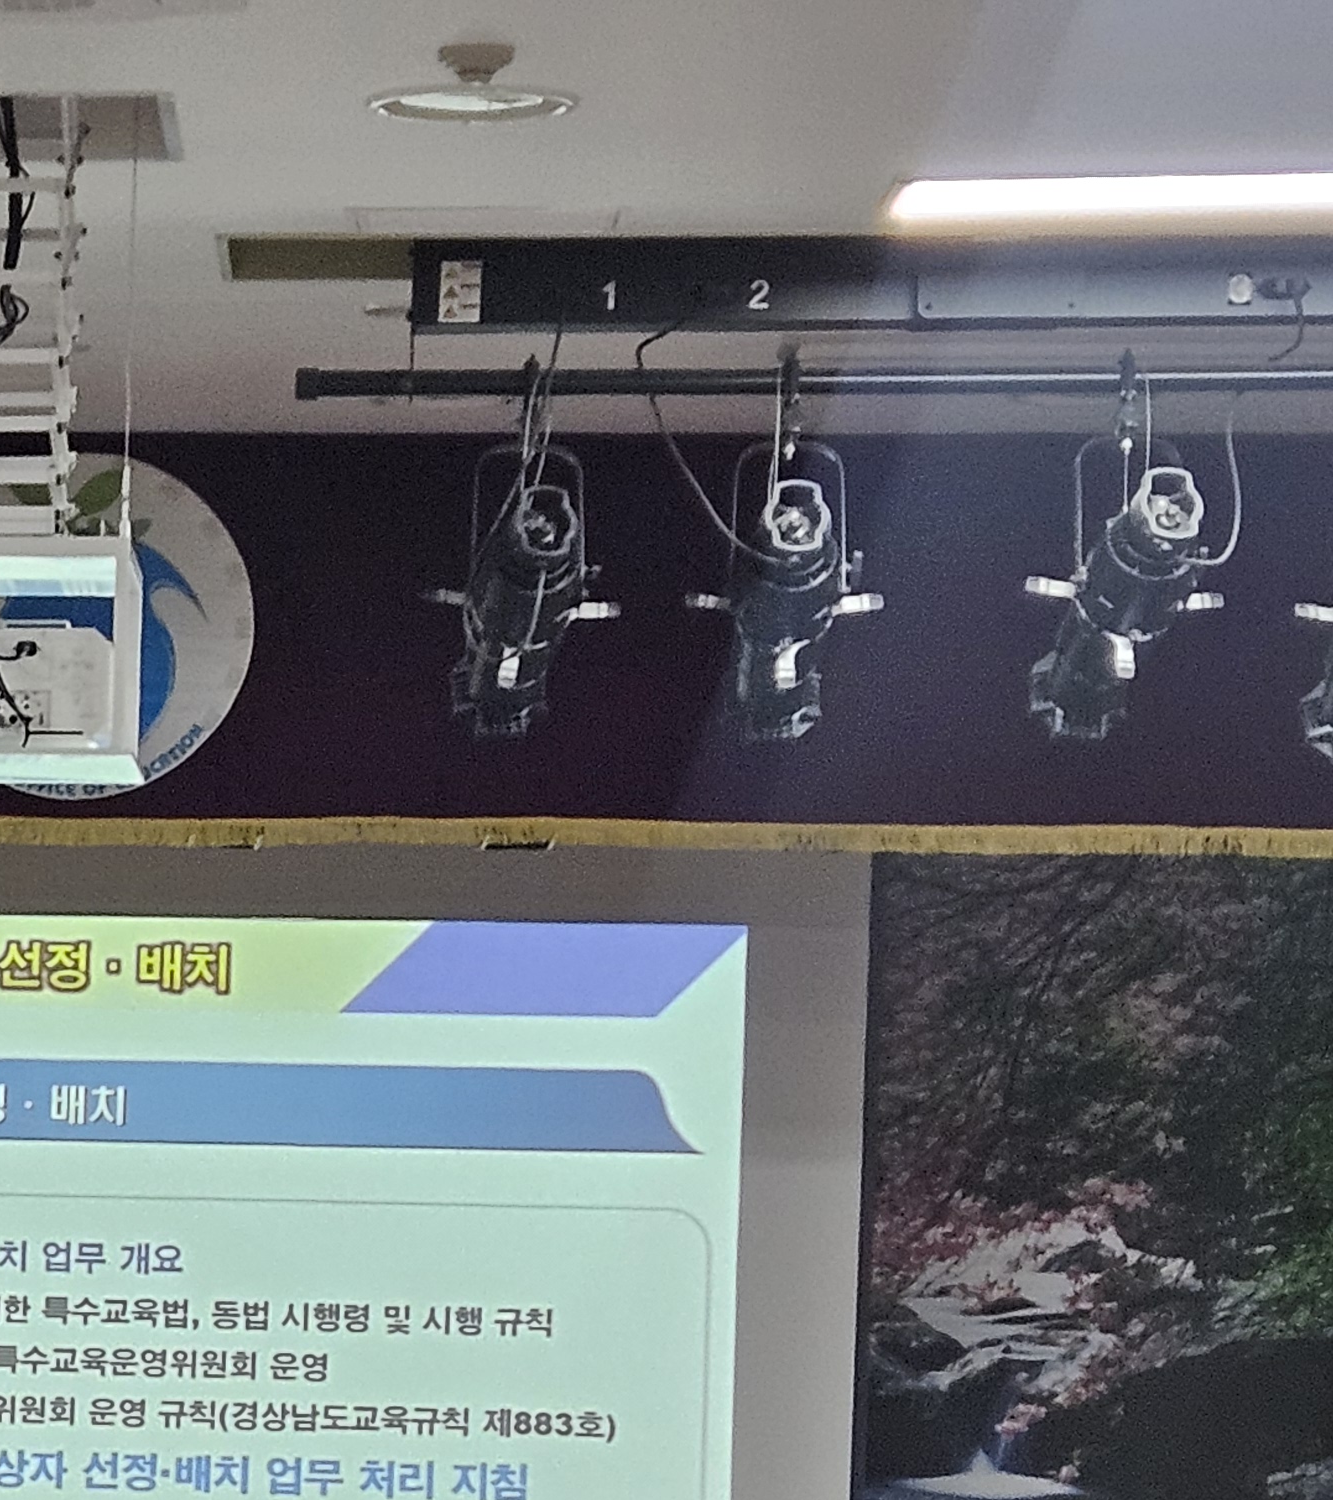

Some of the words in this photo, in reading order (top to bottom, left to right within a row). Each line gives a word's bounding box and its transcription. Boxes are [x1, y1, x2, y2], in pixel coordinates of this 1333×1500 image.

[602, 279, 617, 311] 1
[746, 279, 770, 311] 2
[135, 940, 232, 996] 배치
[50, 1084, 125, 1126] 배치
[42, 1241, 107, 1275] 업무
[120, 1242, 184, 1276] 개요
[41, 1296, 200, 1331] 특수교육법,
[211, 1300, 270, 1331] 동법
[281, 1302, 370, 1333] 시행령
[384, 1304, 411, 1335] 및
[422, 1305, 483, 1337] 시행
[493, 1308, 553, 1338] 규칙
[269, 1352, 328, 1383] 운영
[88, 1398, 146, 1428] 운영
[482, 1408, 616, 1444] 제883호)
[266, 1456, 345, 1497] 업무
[359, 1459, 435, 1500] 처리
